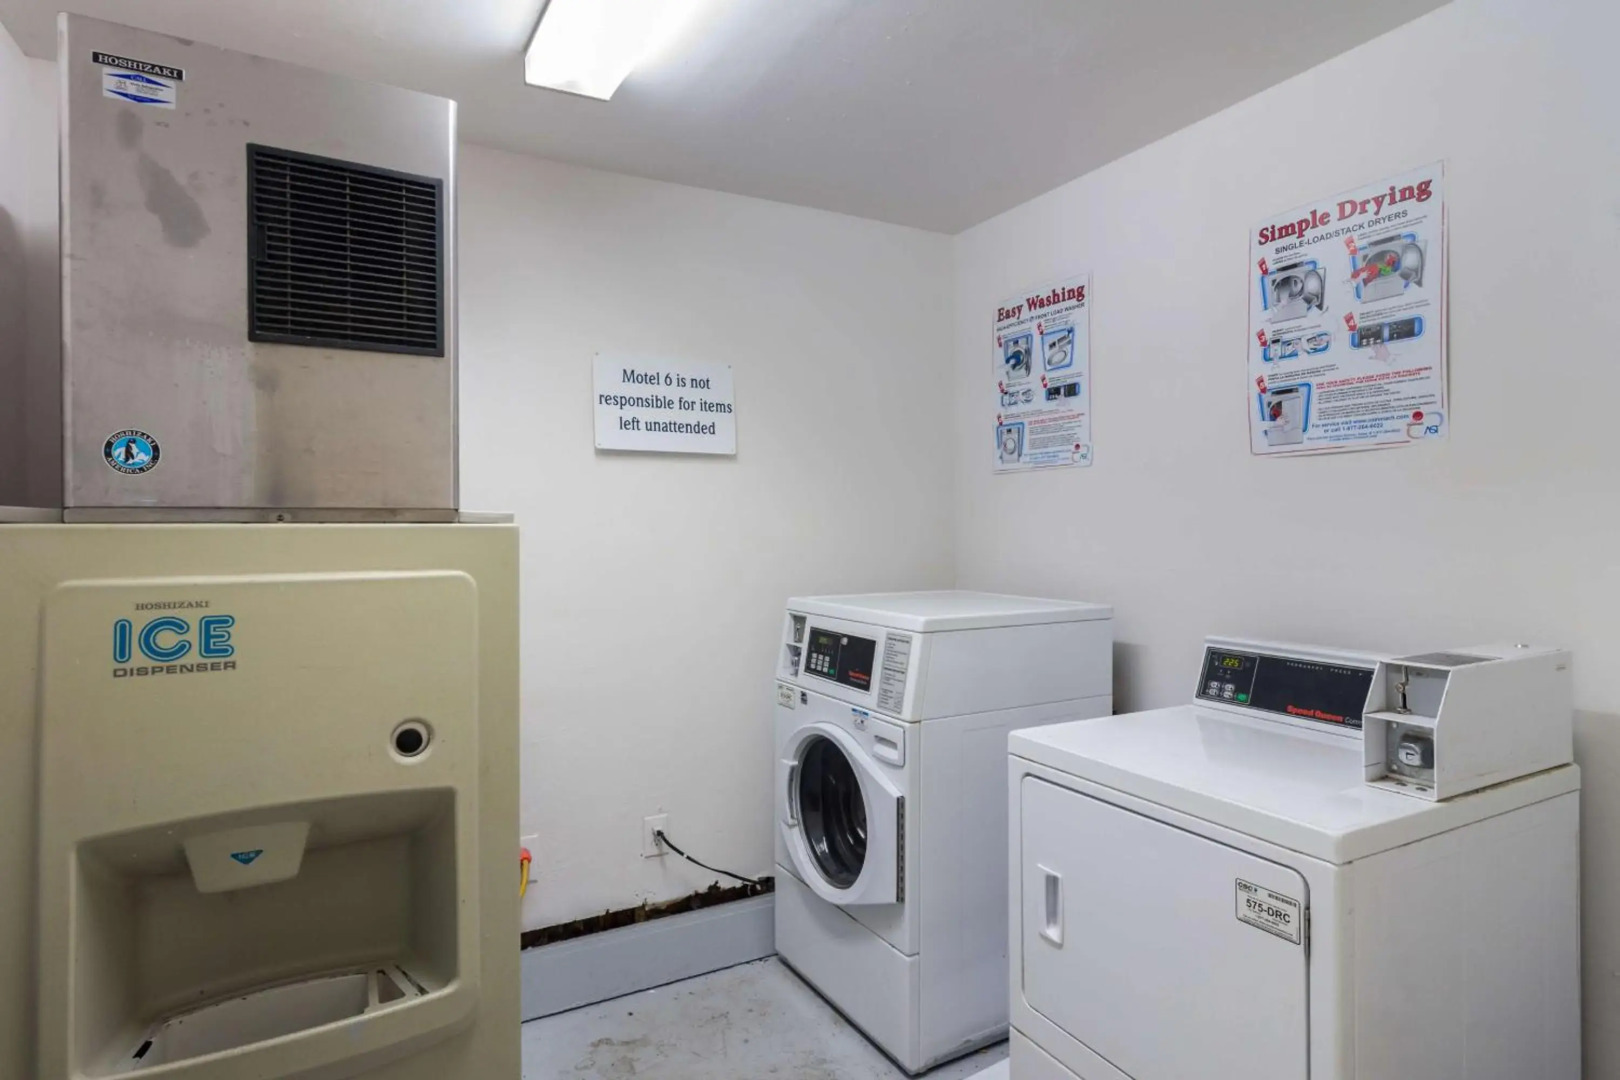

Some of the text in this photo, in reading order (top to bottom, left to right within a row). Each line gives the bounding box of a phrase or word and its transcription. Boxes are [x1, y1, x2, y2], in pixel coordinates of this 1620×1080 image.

[98, 54, 178, 79] HOSHIZAKI
[1258, 208, 1331, 246] Simple
[1336, 178, 1433, 222] Drying
[1274, 222, 1365, 255] SINGLE-LOAD/STACK
[1368, 209, 1408, 228] DRYERS
[997, 304, 1024, 323] Easy
[1026, 285, 1085, 312] Washing
[622, 368, 710, 390] Motel 6 is not
[599, 393, 733, 414] responsible for items
[619, 416, 716, 435] left unattended
[135, 600, 210, 611] HOSHIZAKI
[113, 614, 235, 663] ICE
[113, 660, 237, 678] DISPENSER
[1222, 657, 1240, 668] 225
[1245, 897, 1291, 924] 575-DRC
